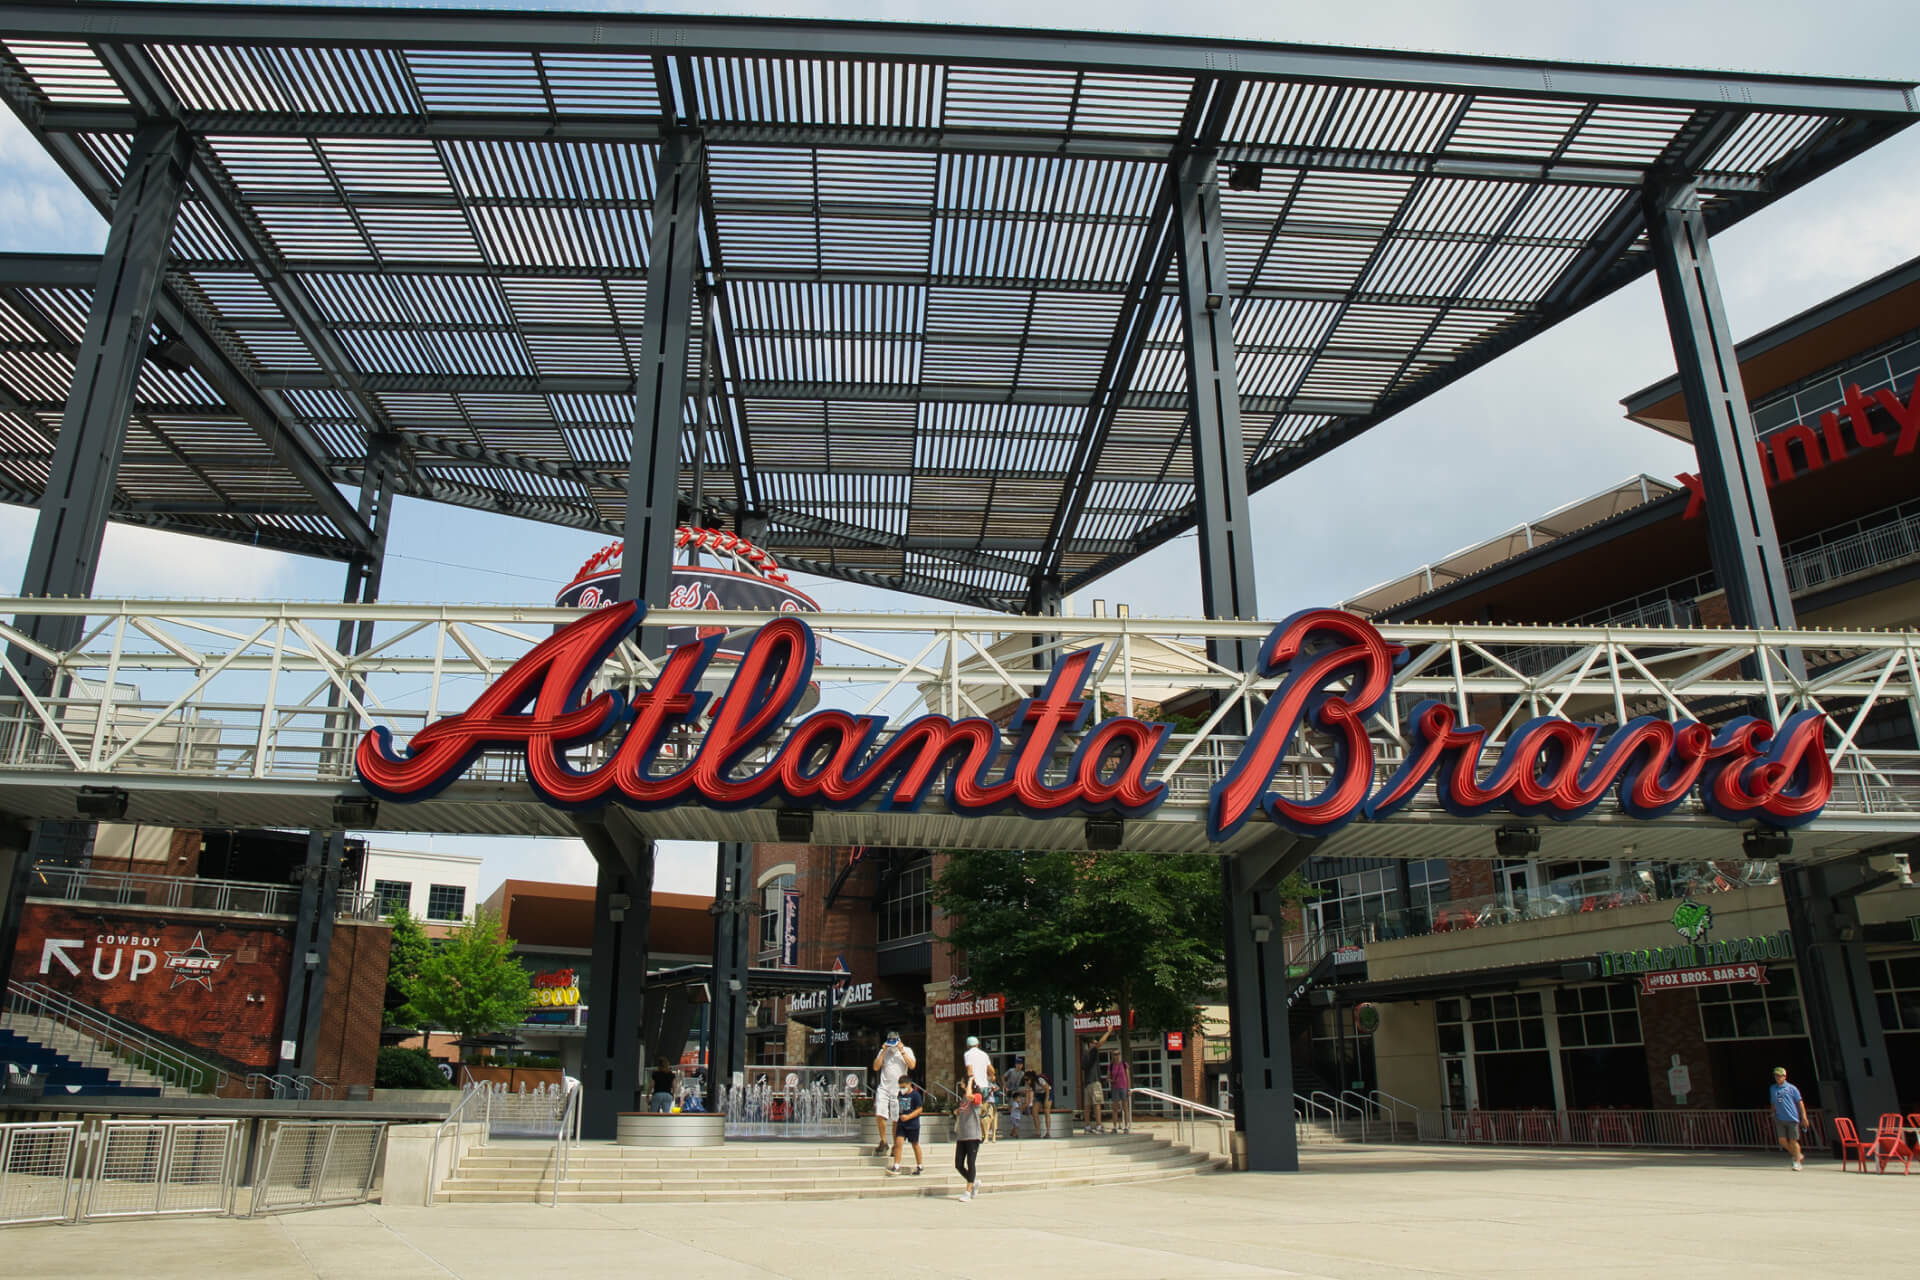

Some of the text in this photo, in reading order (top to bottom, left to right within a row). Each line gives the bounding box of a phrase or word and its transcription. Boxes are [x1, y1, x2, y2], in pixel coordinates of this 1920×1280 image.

[356, 599, 1835, 843] Atlanta Braves
[97, 934, 160, 947] COWBOY
[92, 947, 157, 981] UP
[169, 958, 220, 969] PBR
[1600, 943, 1697, 977] TERRAPIN
[1659, 974, 1679, 986] FOX
[1713, 966, 1758, 980] BAR-B-Q
[975, 998, 999, 1014] STORE
